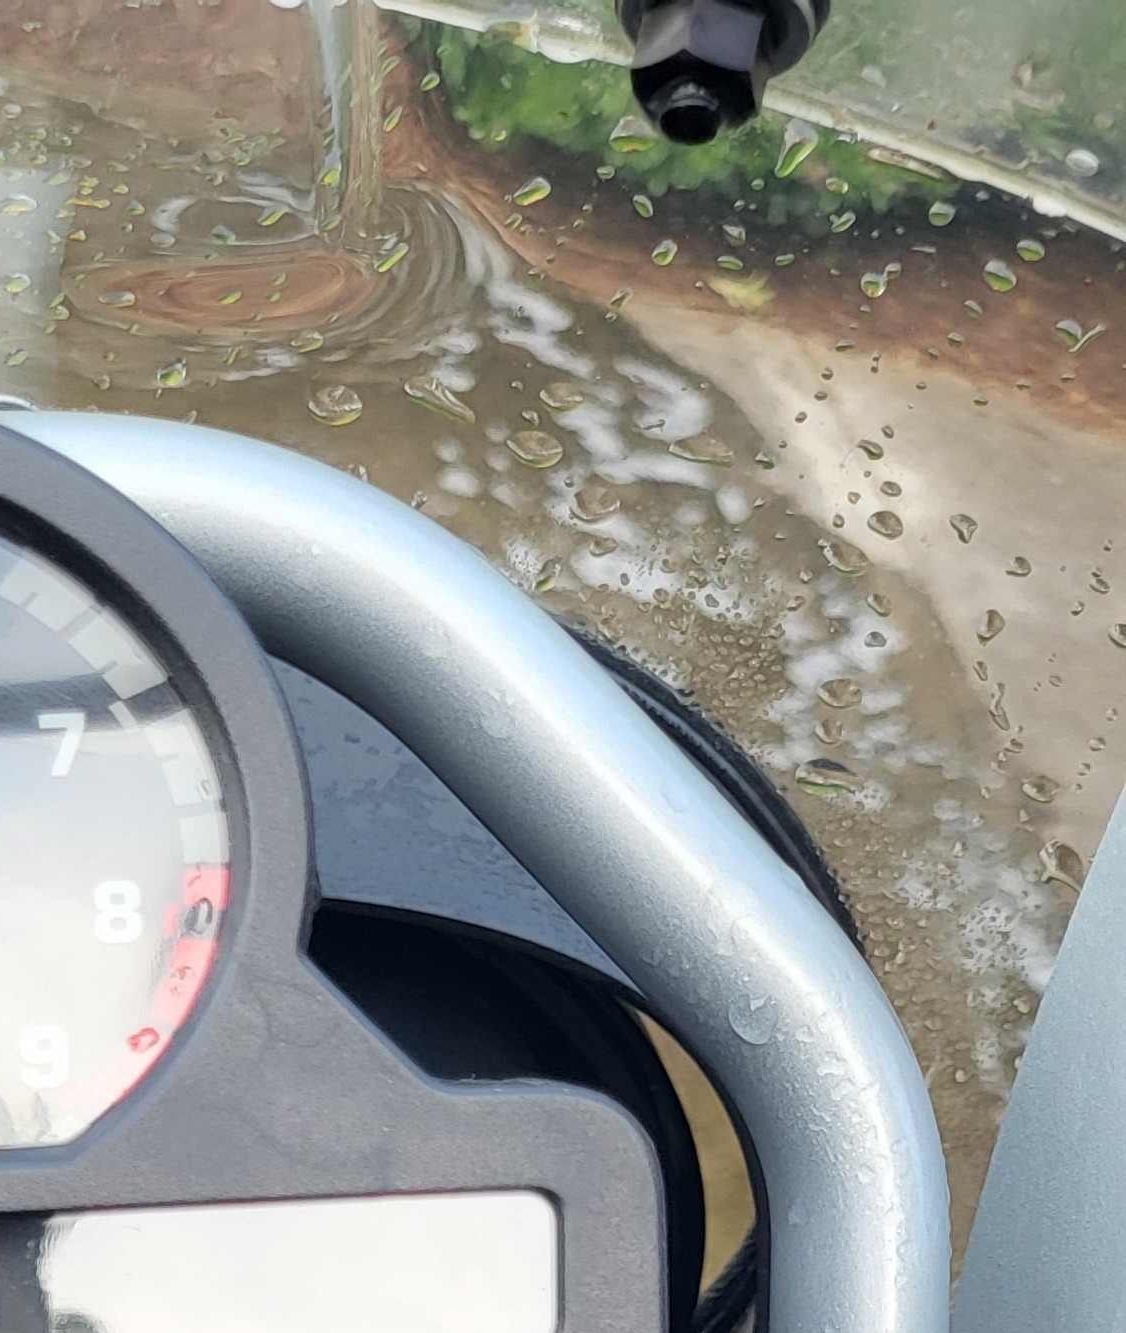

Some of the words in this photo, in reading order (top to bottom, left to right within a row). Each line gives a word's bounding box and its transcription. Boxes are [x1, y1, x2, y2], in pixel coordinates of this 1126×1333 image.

[38, 713, 85, 777] 7
[93, 880, 143, 944] 8
[20, 1025, 70, 1088] 9
